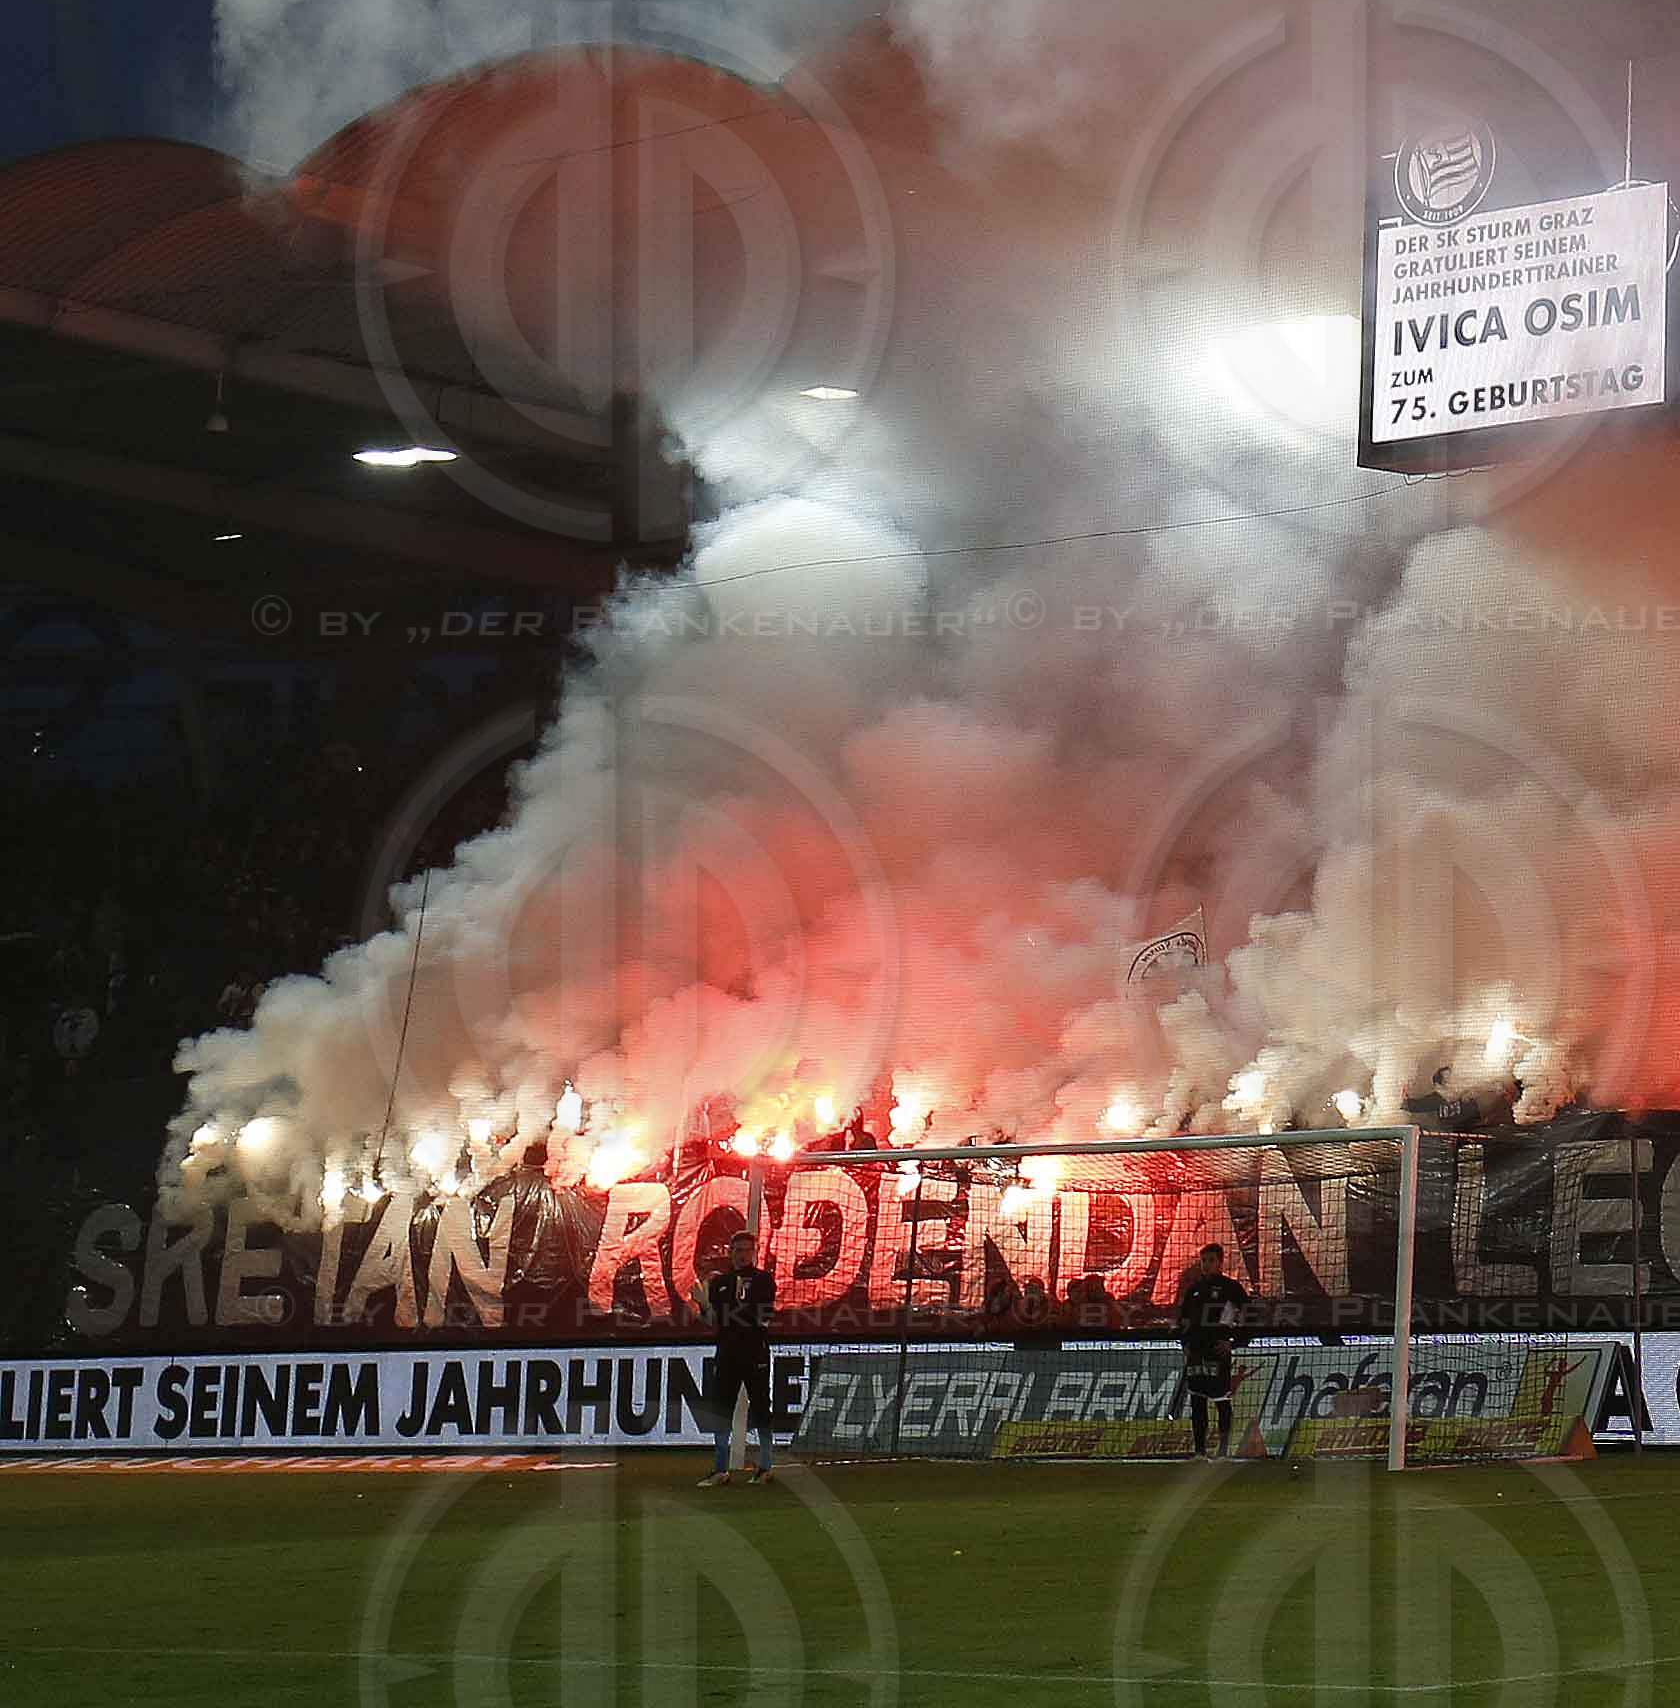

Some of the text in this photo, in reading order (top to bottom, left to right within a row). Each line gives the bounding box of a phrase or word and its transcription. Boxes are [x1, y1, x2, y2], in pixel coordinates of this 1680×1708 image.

[1393, 233, 1587, 280] GRATULIERT SEINEM
[1394, 207, 1594, 256] DER SK STURM GRAZ
[1392, 253, 1619, 306] JAHRHUNDERTTRAINER
[1393, 283, 1641, 357] IVICA OSIM
[1390, 367, 1434, 389] ZUM
[1390, 364, 1644, 425] 75. GEBURTSTAG
[153, 1363, 380, 1439] SEINEM
